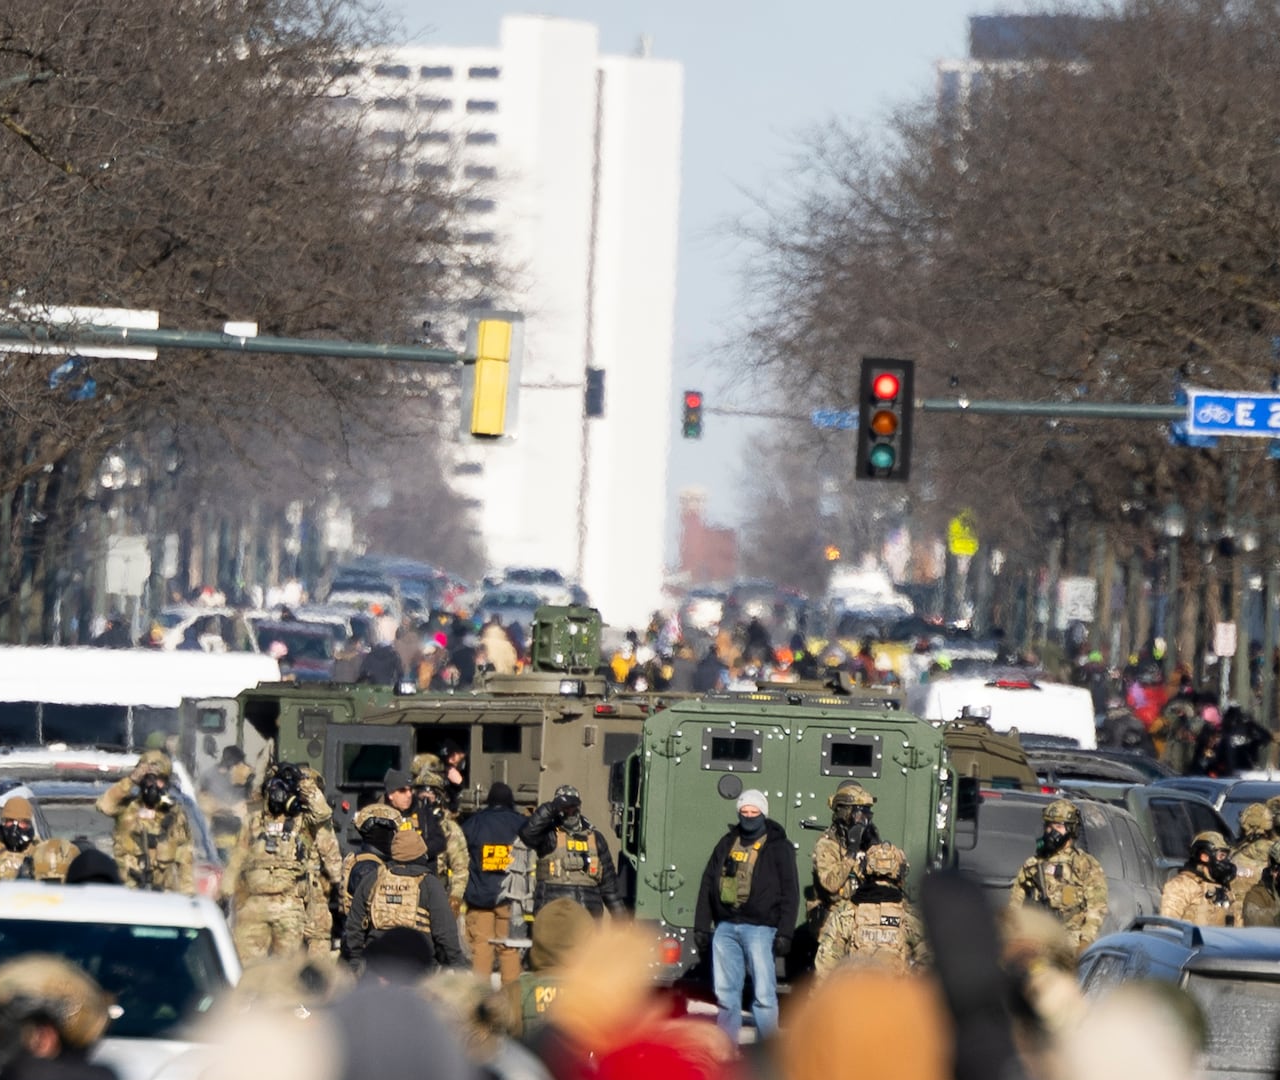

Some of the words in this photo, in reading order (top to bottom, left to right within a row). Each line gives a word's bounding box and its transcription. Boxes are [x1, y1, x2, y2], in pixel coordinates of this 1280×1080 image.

[1234, 401, 1257, 428] E
[567, 840, 588, 852] FBI
[731, 850, 749, 863] FBI
[380, 884, 411, 892] POLICE
